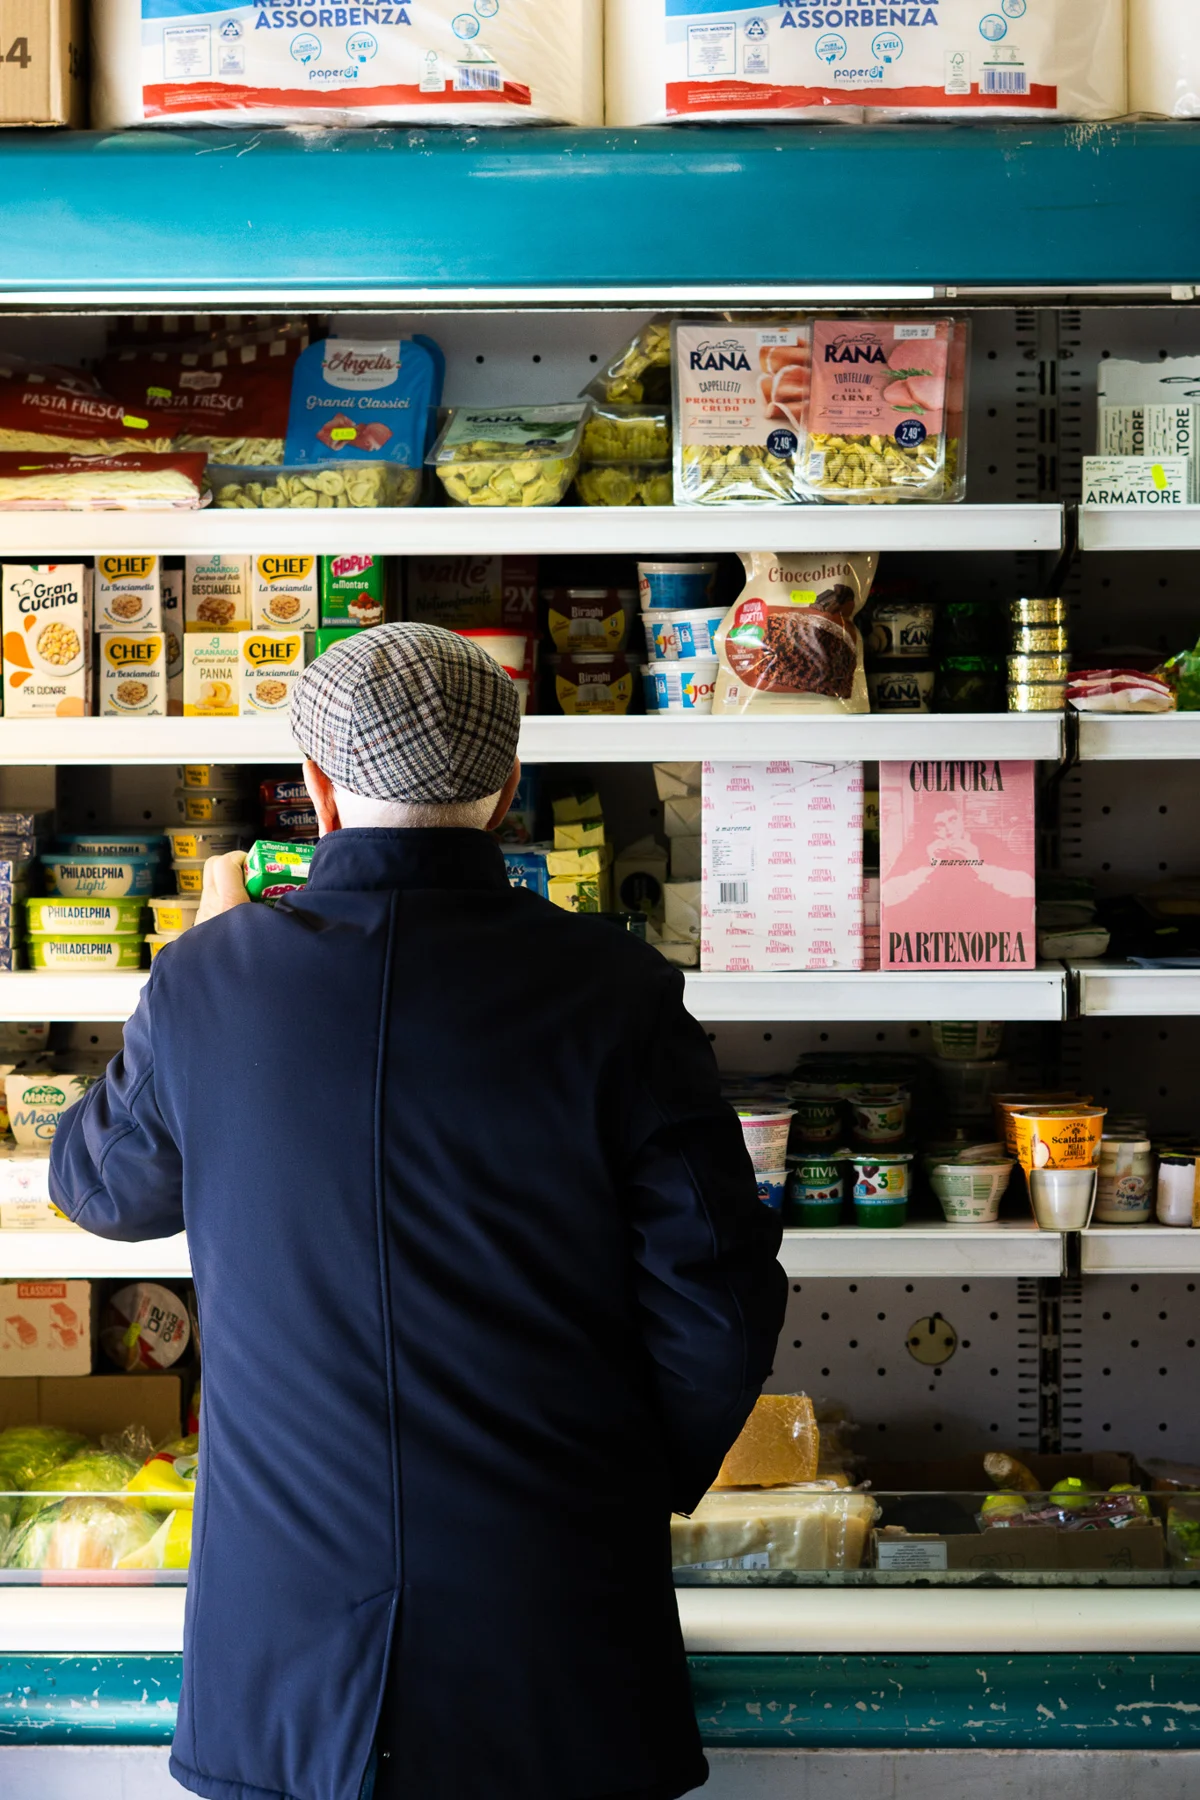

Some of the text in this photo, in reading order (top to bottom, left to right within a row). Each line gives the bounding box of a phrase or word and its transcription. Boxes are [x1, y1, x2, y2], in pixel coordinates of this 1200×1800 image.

[255, 8, 412, 29] ASSORBENZA
[780, 8, 938, 29] ASSORBENZA
[358, 41, 373, 49] VELI
[883, 41, 899, 49] VELI
[0, 37, 31, 68] 4
[691, 351, 752, 371] RANA
[824, 344, 887, 364] RANA
[328, 351, 395, 376] Angelis
[834, 373, 873, 385] TORTELLINI
[699, 380, 742, 394] CAPPELLETTI
[22, 393, 67, 410] PASTA
[72, 398, 125, 420] FRESCA
[146, 392, 244, 411] PASTA FRESCA
[306, 396, 410, 410] Grandi Classici
[1176, 408, 1190, 456] TORE
[1086, 490, 1182, 504] ARMATORE
[104, 558, 151, 572] CHEF
[263, 558, 309, 573] CHEF
[768, 563, 851, 583] Cioccolato
[34, 582, 72, 598] Gran
[111, 584, 154, 592] Besciamella
[192, 584, 241, 595] BESCIAMELLA
[19, 592, 78, 613] Cucina
[504, 586, 535, 612] 2X
[571, 605, 603, 618] Biraghi
[743, 602, 761, 612] NUOVA
[740, 612, 764, 623] RICETTA
[110, 644, 156, 659] CHEF
[249, 643, 296, 658] CHEF
[200, 668, 232, 679] PANNA
[578, 671, 610, 684] Biraghi
[23, 685, 66, 695] PER CUCINARE
[877, 684, 920, 700] RANA
[910, 760, 1004, 792] CULTURA
[77, 845, 140, 854] PHILADELPHIA
[60, 866, 124, 879] PHILADELPHIA
[75, 880, 108, 895] Light
[48, 906, 111, 918] PHILADELPHIA
[50, 942, 112, 955] PHILADELPHIA
[888, 932, 1027, 963] PARTENOPEA
[23, 1091, 64, 1104] Matese
[799, 1107, 836, 1118] CTIVIA
[878, 1114, 888, 1128] 3
[796, 1166, 838, 1178] ACTIVIA
[877, 1173, 888, 1188] 3
